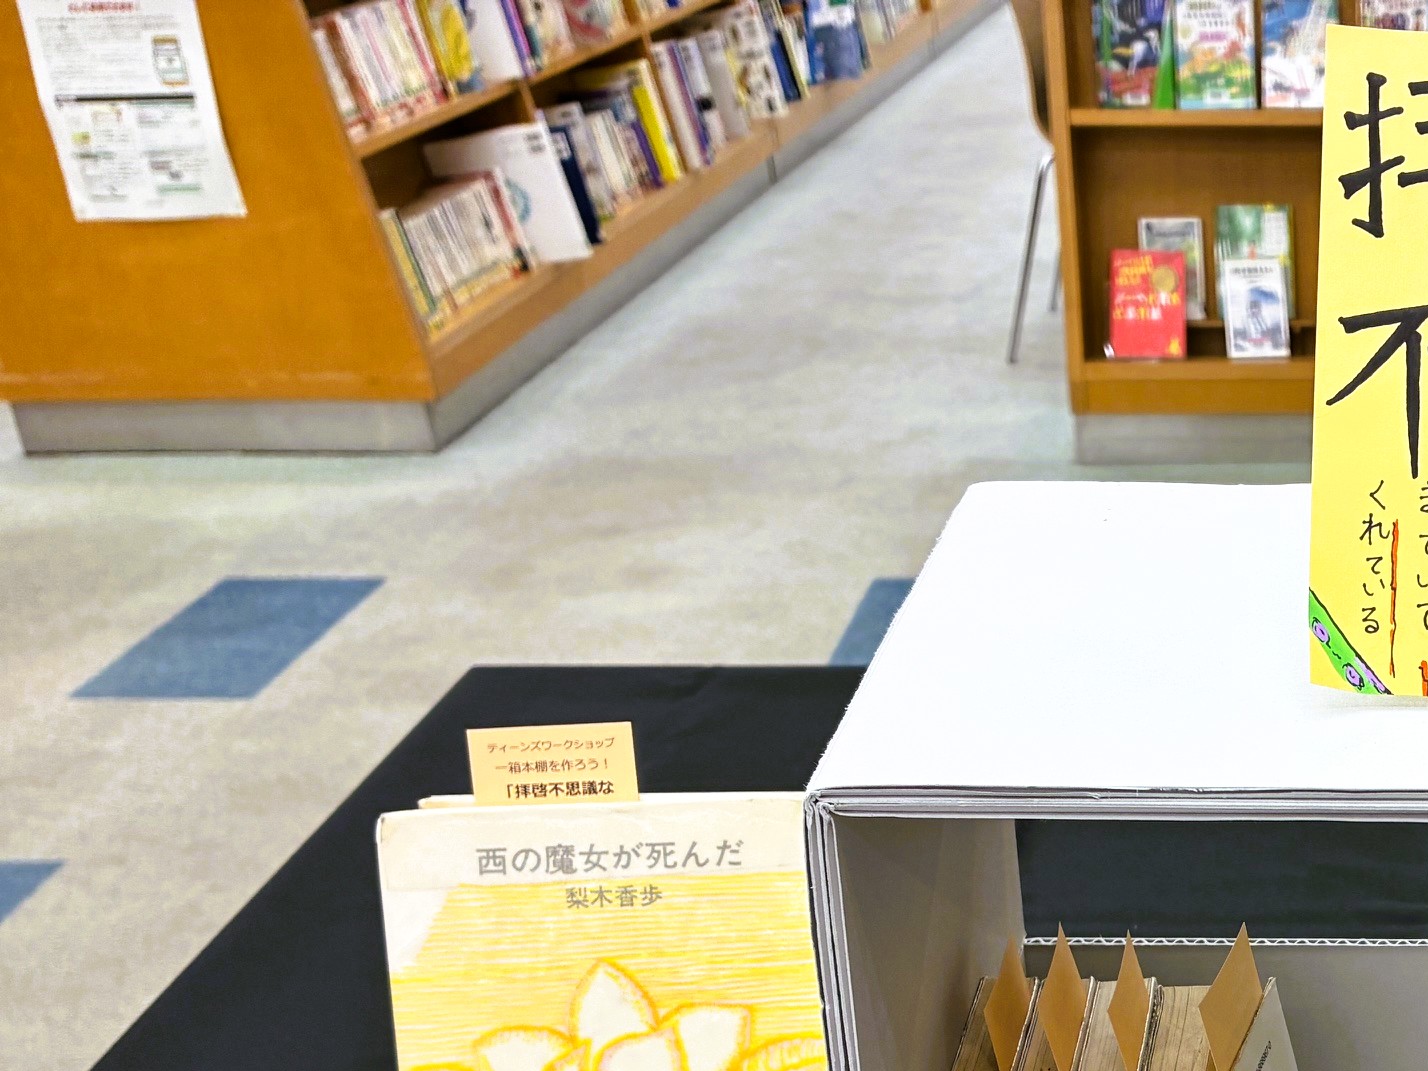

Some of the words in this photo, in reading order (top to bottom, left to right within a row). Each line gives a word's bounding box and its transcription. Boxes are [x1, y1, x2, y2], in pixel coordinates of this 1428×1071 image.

[1358, 479, 1392, 635] くれている
[487, 737, 615, 754] ティーンズワークショップ
[507, 780, 615, 799] 「拝啓不思議な
[476, 839, 745, 876] 西の魔女が死んだ
[566, 885, 664, 910] 梨木香歩
